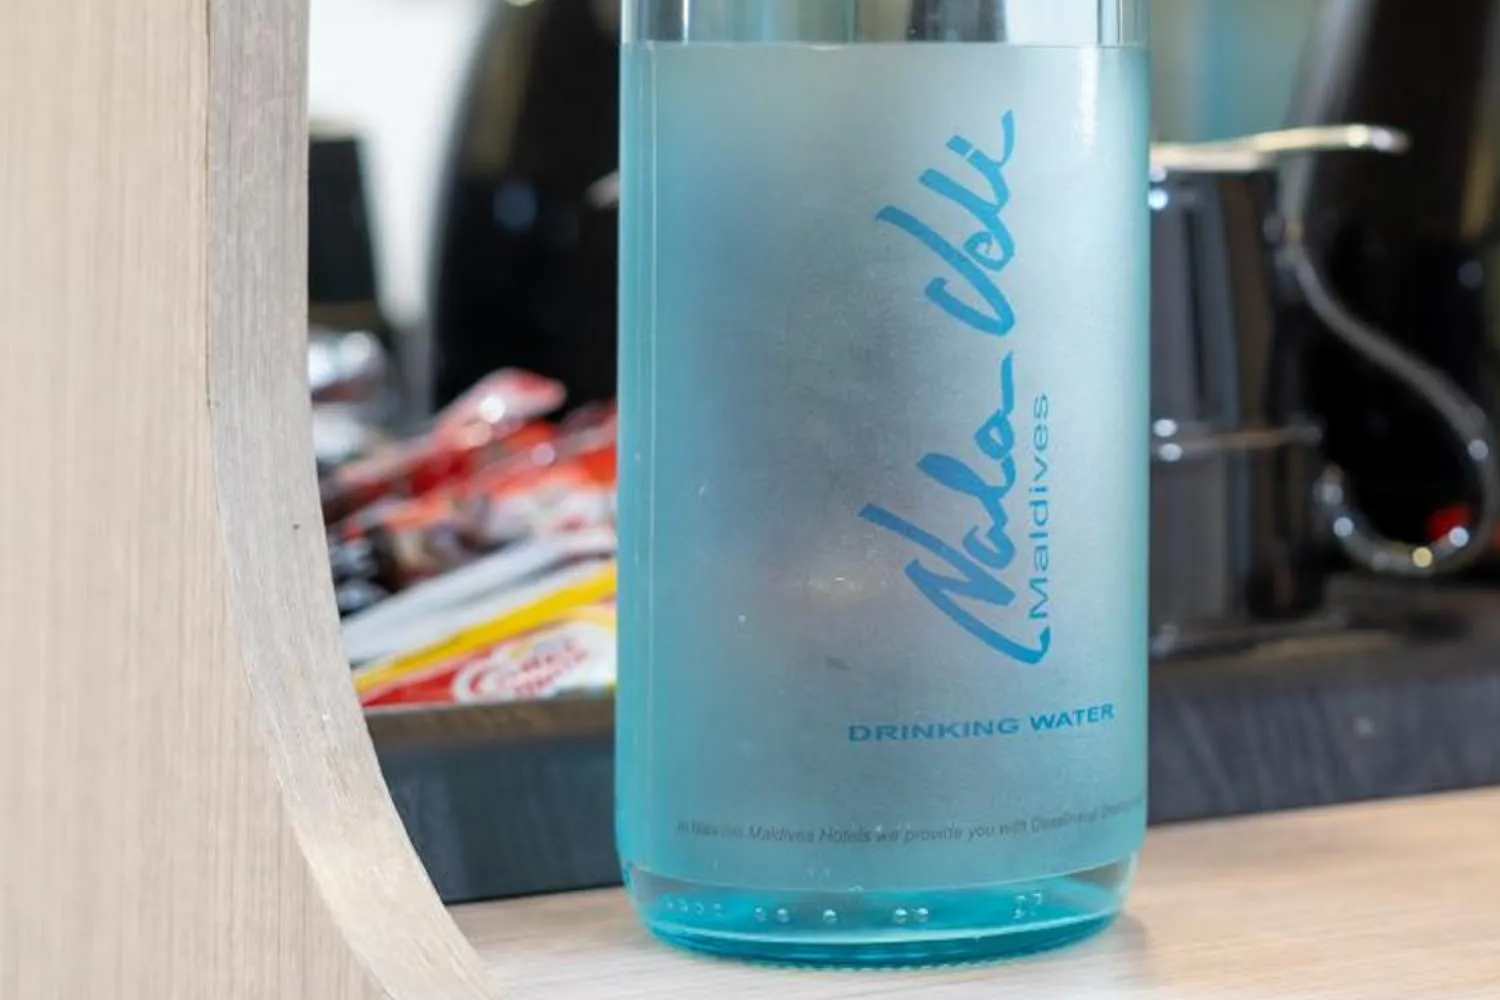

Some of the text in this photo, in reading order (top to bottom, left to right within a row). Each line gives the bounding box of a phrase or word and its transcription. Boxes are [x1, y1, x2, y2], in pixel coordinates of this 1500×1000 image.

[858, 350, 1051, 665] Nala
[1028, 393, 1050, 620] Maldives
[847, 703, 1116, 742] DRINKING WATER
[966, 820, 995, 844] you
